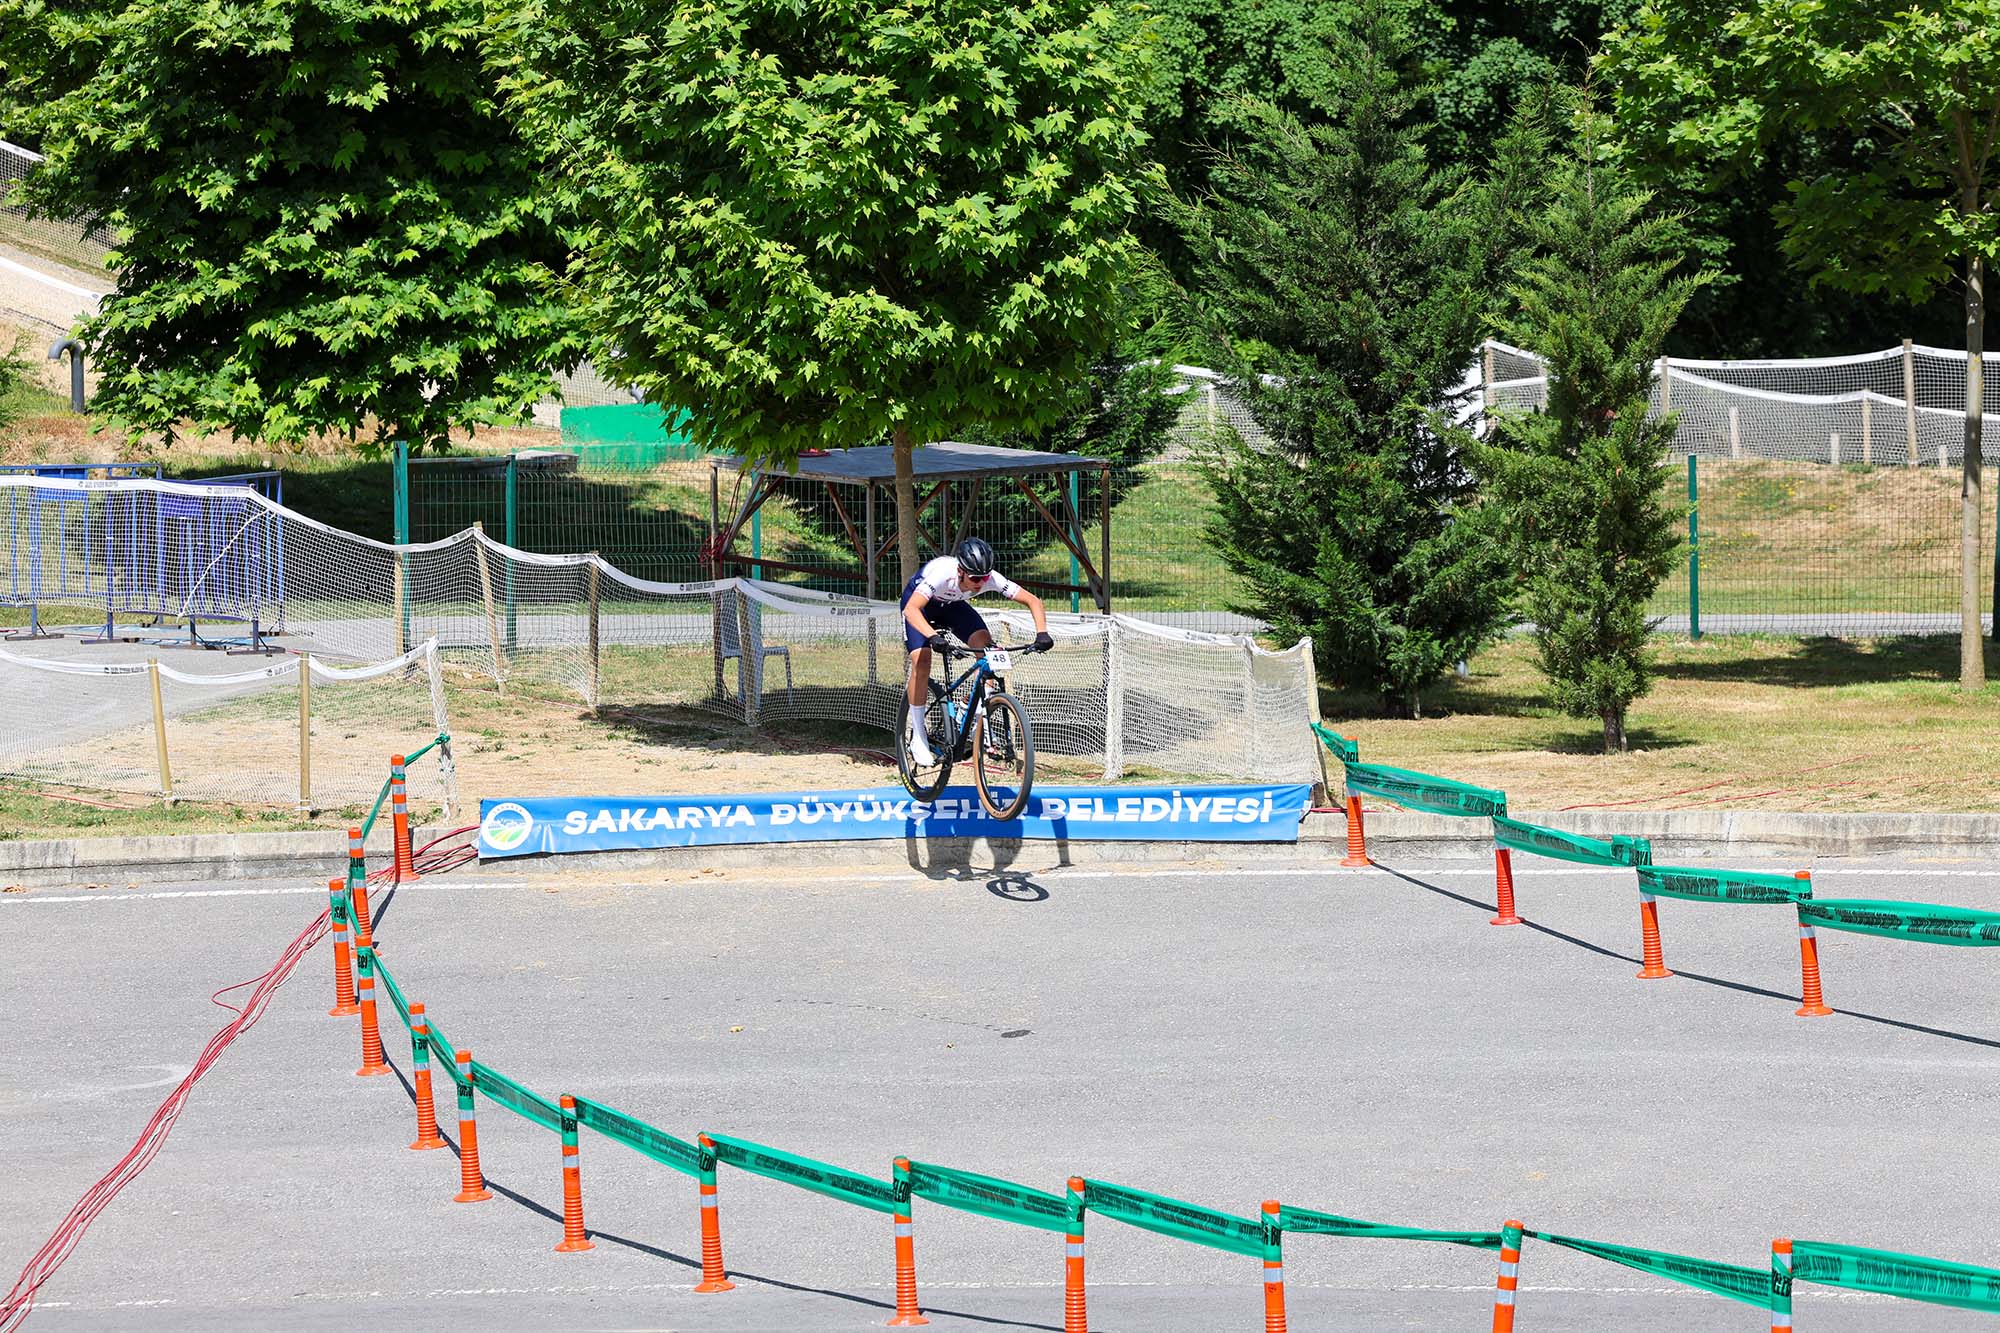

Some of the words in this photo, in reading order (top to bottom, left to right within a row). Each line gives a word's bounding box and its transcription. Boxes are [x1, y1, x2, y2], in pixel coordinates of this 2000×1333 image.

[992, 653, 1007, 663] 48
[564, 805, 755, 836] SAKARYA
[1040, 790, 1275, 823] BELEDİYESİ
